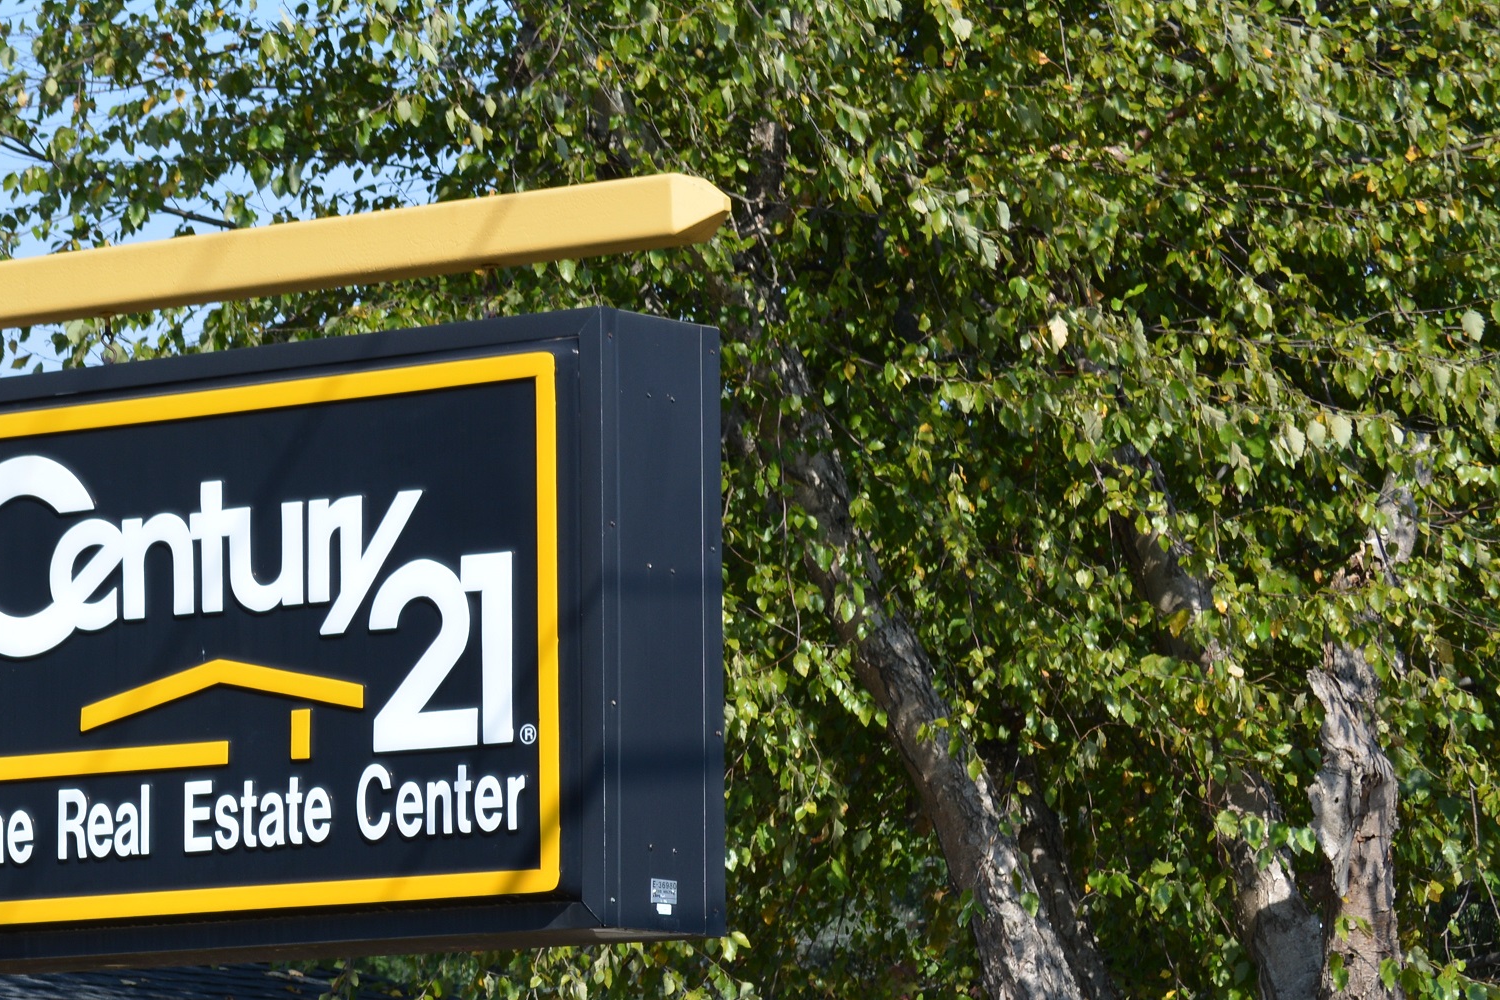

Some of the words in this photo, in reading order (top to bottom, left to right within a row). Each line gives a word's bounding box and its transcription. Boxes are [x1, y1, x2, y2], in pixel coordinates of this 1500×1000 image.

[368, 550, 515, 753] 21
[57, 783, 150, 860] Real
[183, 776, 332, 854] Estate
[356, 763, 526, 841] Center
